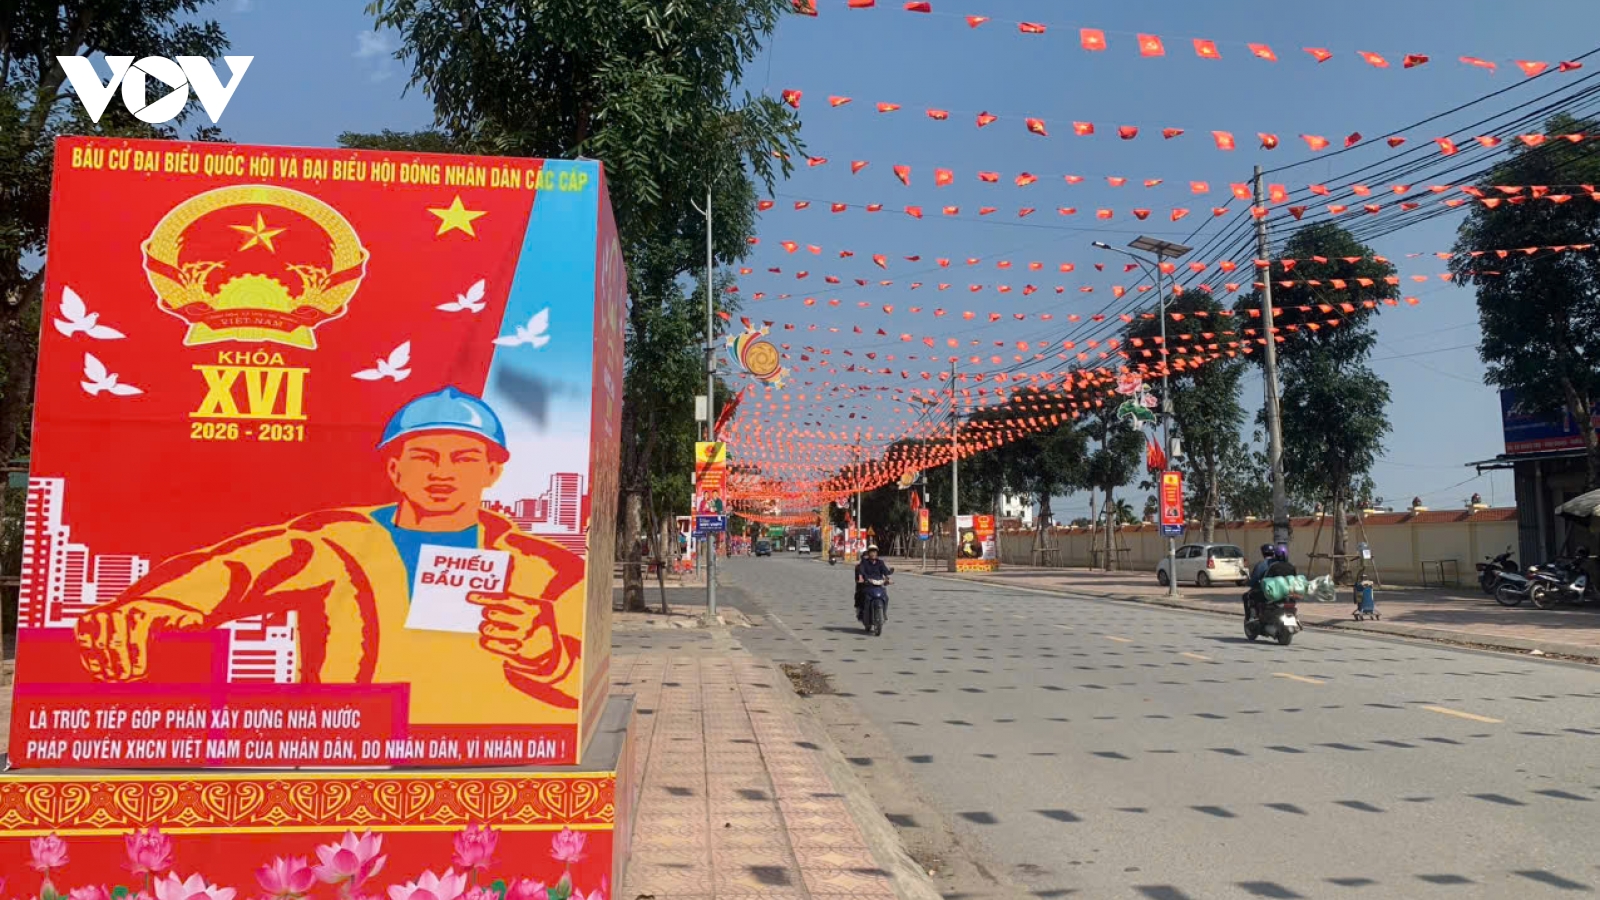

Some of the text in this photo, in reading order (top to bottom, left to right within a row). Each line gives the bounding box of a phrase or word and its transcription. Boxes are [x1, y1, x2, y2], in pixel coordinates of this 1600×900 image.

[72, 140, 589, 192] BẦU CỬ ĐẠI BIỂU QUỐC HỘI VÀ ĐẠI BIỂU HỘI ĐỒNG NHÂN DÂN CÁC CẤP
[218, 348, 285, 365] KHÓA
[189, 364, 311, 420] XVI
[190, 422, 239, 440] 2026
[258, 424, 304, 442] 2031
[433, 555, 494, 573] PHIẾU
[469, 574, 501, 591] CỬ
[29, 703, 361, 733] LÀ TRỰC TIẾP GÓP PHẦN XÂY DỰNG NHÀ NƯỚC
[26, 732, 566, 763] PHÁP QUYỀN XHCN VIỆT NAM CỦA NHÂN DÂN, DO NHÂN DÂN, VÌ NHÂN DÂN !
